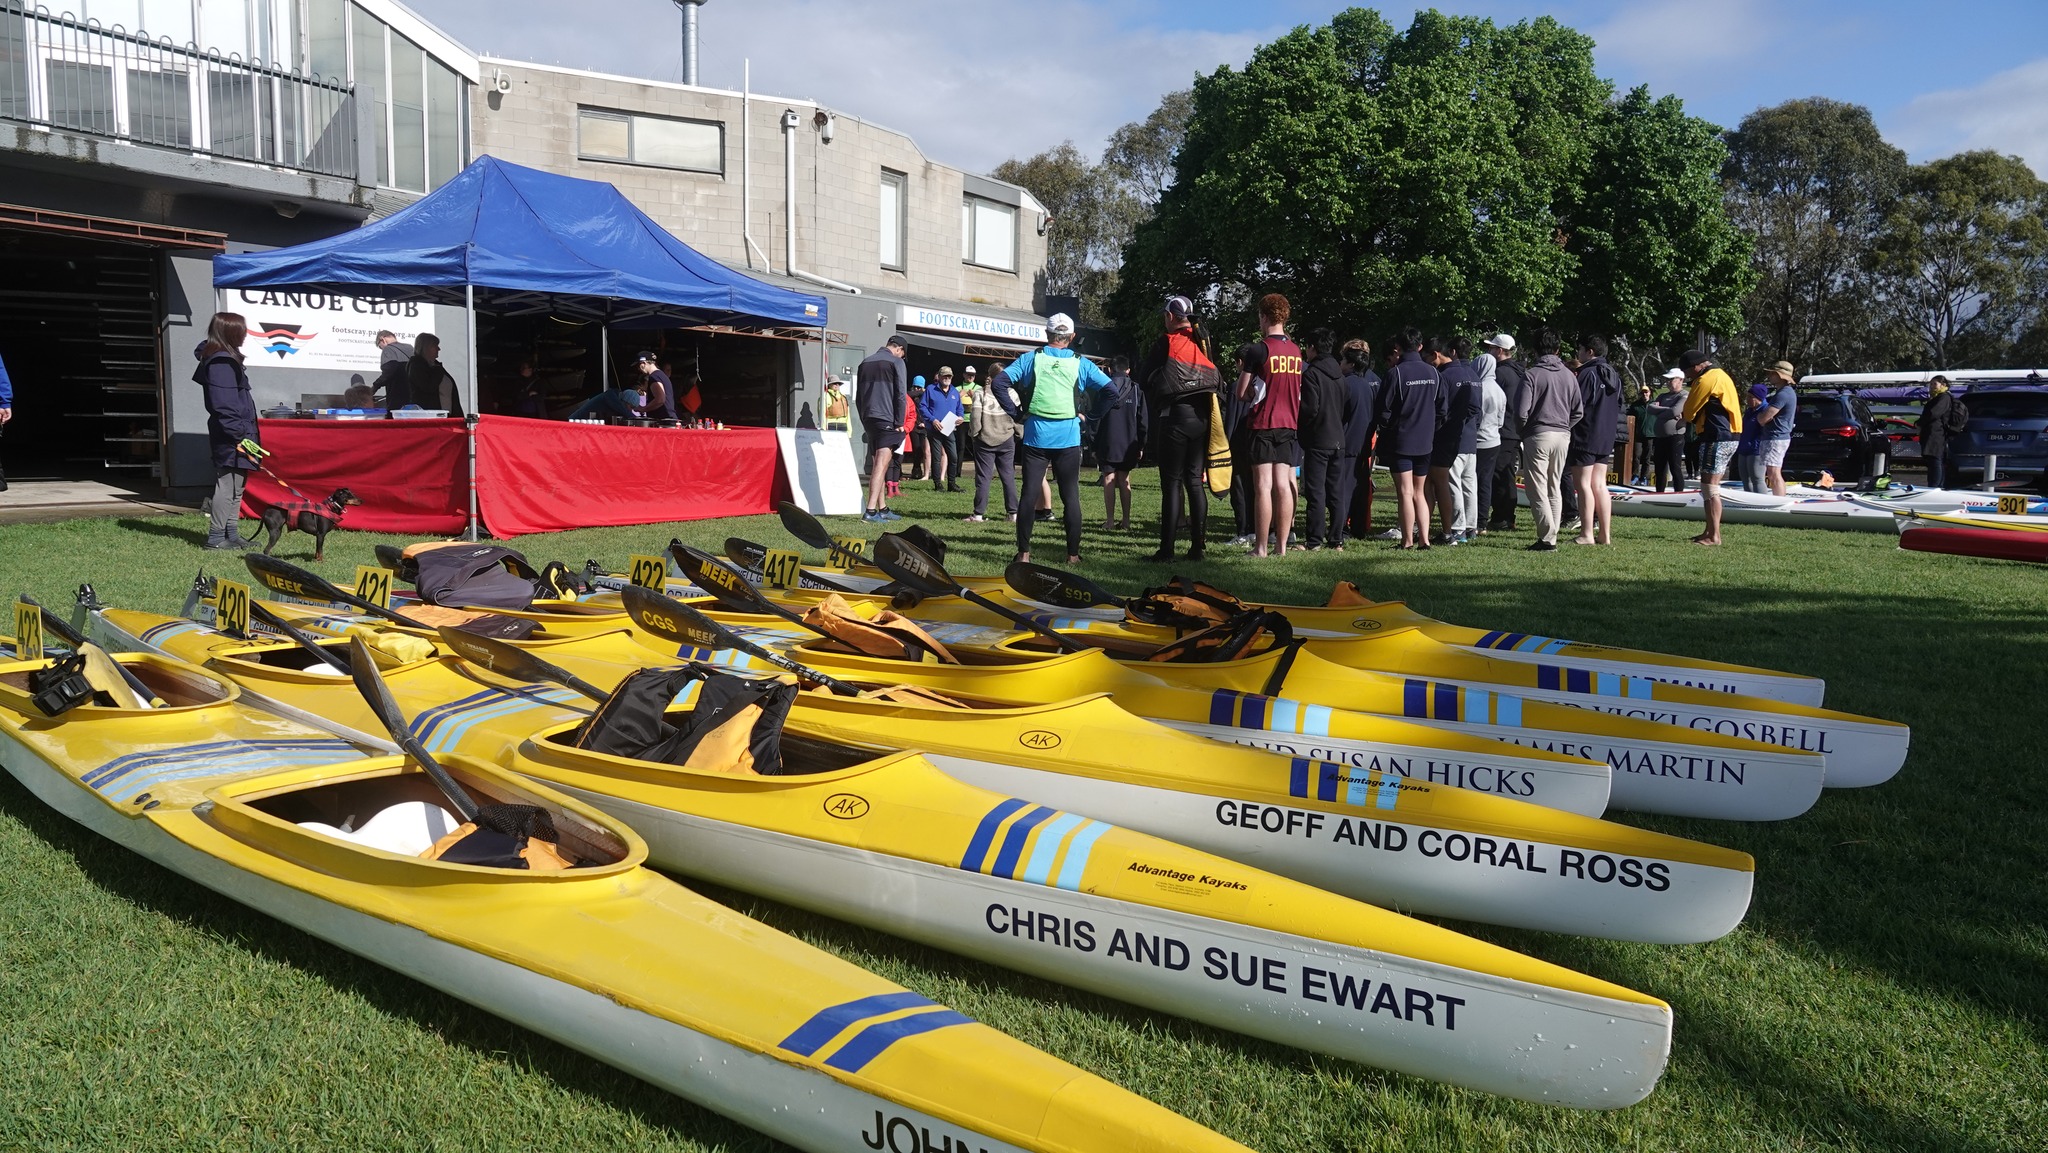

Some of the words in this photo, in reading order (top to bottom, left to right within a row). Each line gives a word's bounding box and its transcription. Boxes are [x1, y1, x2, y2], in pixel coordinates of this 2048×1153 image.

[240, 289, 343, 312] CANOE
[352, 297, 419, 318] CLUB
[919, 311, 981, 331] FOOTSCRAY
[983, 320, 1015, 336] CANOE
[1018, 325, 1041, 338] CLUB
[2000, 497, 2025, 513] 301
[631, 559, 664, 595] 422
[700, 559, 738, 592] MEEK
[766, 553, 799, 586] 417
[894, 550, 929, 579] MEEK
[265, 573, 305, 595] MEEK
[356, 571, 389, 610] 421
[1064, 587, 1092, 603] CGS
[217, 584, 247, 631] 420
[642, 610, 678, 633] CGS
[17, 608, 41, 659] 423
[687, 627, 717, 644] MEEK
[1026, 733, 1054, 746] AK
[1690, 716, 1834, 755] GOSBELL
[1426, 760, 1536, 797] HICKS
[1606, 748, 1746, 786] MARTIN
[1326, 773, 1385, 788] Advantage
[1388, 781, 1431, 793] Kayaks
[831, 798, 862, 815] AK
[1215, 800, 1325, 839] GEOFF
[1333, 817, 1408, 853] AND
[1417, 829, 1548, 875] CORAL
[1559, 848, 1672, 893] ROSS
[1127, 861, 1196, 882] Advantage
[1198, 875, 1248, 891] Kayaks
[985, 903, 1097, 953] CHRIS
[1106, 928, 1191, 972] AND
[1203, 947, 1288, 995] SUE
[1301, 965, 1466, 1032] EWART
